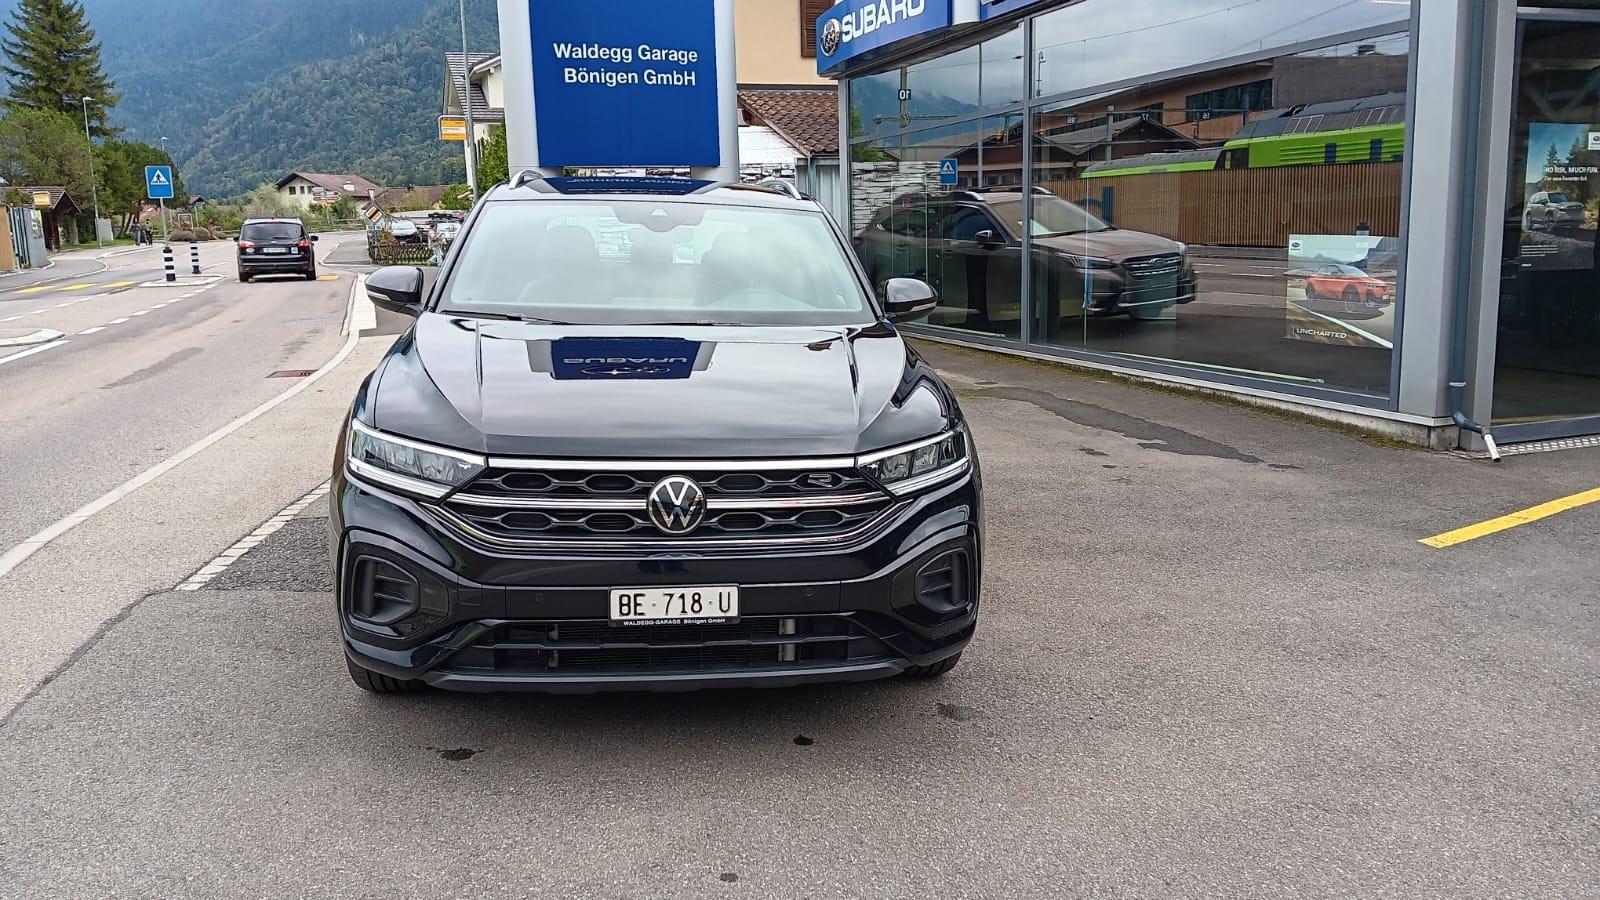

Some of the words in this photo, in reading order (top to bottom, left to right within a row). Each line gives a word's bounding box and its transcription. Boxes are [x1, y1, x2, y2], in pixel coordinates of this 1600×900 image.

[841, 0, 926, 43] SUBARU
[553, 42, 633, 64] Waldegg
[637, 44, 698, 65] Garage
[563, 67, 639, 88] Bönigen
[643, 69, 697, 87] GmbH
[1296, 327, 1347, 339] UNCHARTED
[618, 593, 646, 617] BE
[663, 591, 703, 616] 718
[718, 591, 731, 614] U
